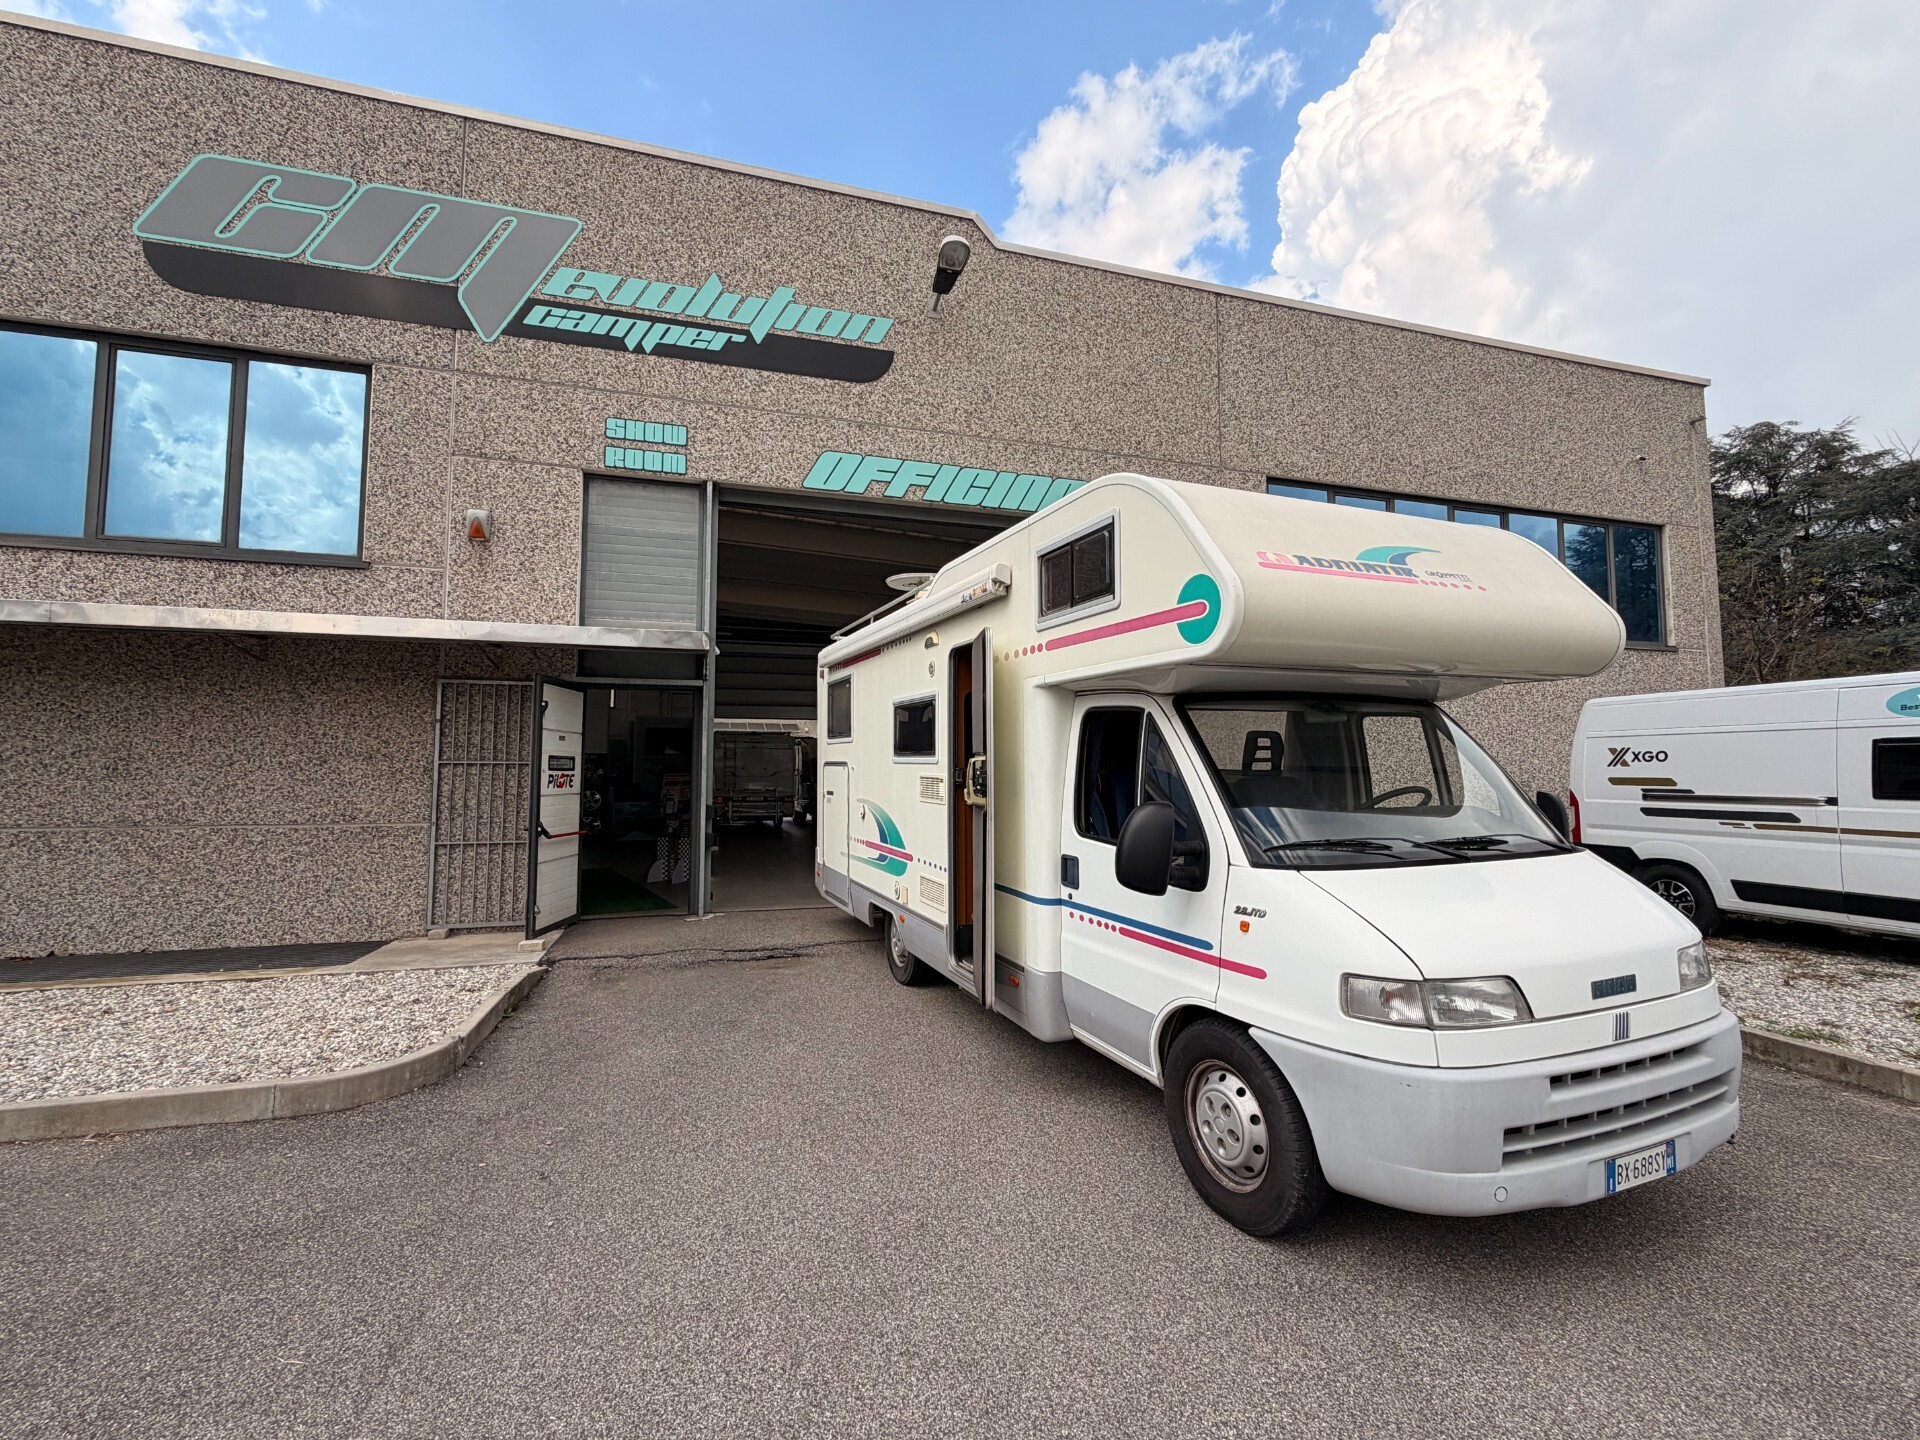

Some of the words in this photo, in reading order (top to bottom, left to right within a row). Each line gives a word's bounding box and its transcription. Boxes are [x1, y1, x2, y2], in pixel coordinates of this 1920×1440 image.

[522, 305, 747, 354] camper
[605, 417, 688, 447] SHOW
[604, 446, 687, 476] ROOM
[1631, 750, 1669, 763] XGO
